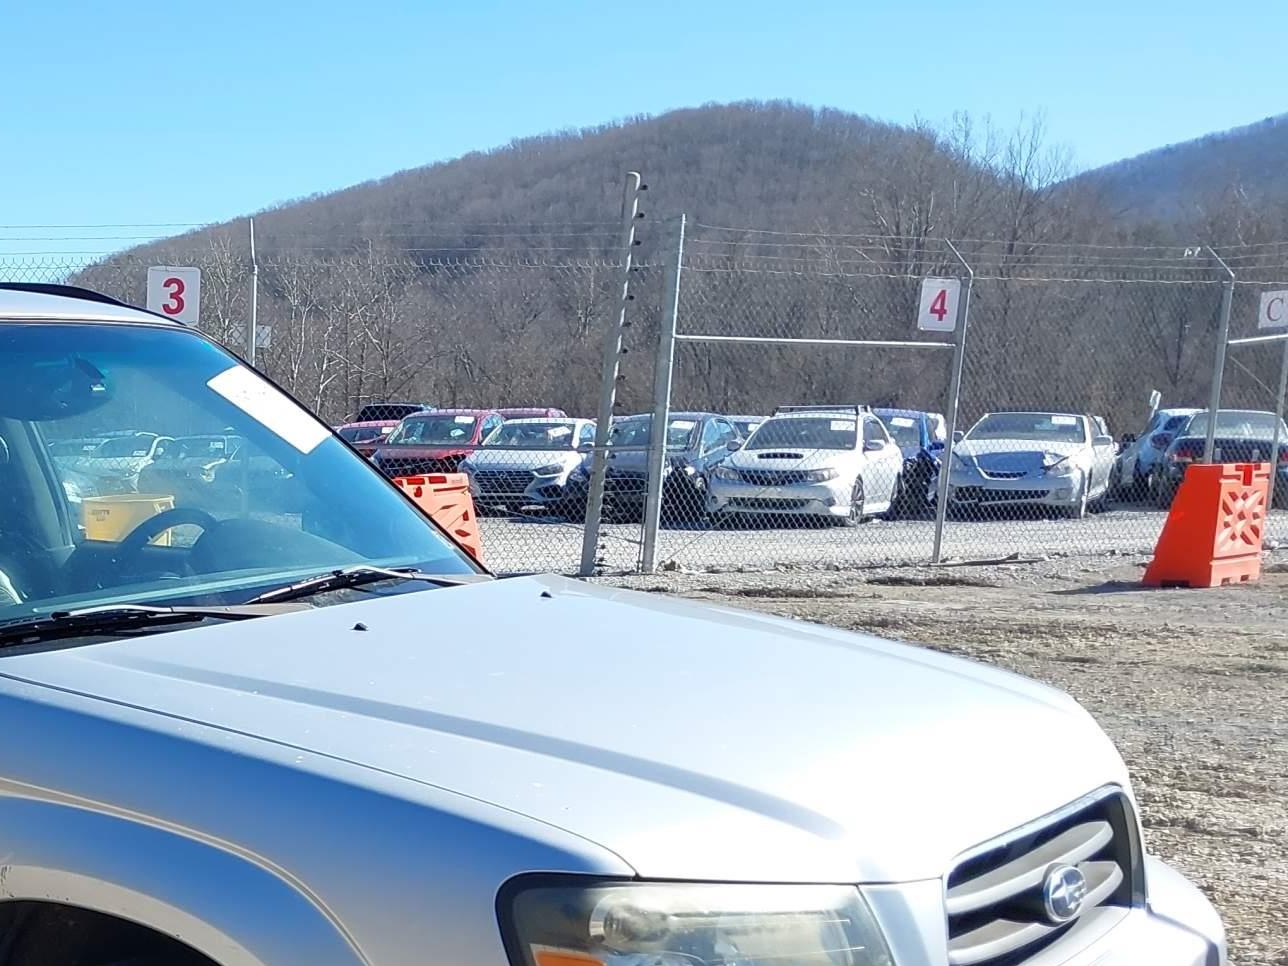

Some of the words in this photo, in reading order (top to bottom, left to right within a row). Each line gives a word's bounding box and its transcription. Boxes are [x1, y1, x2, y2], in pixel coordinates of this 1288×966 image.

[162, 278, 185, 315] 3
[929, 289, 948, 321] 4
[1267, 297, 1284, 322] C
